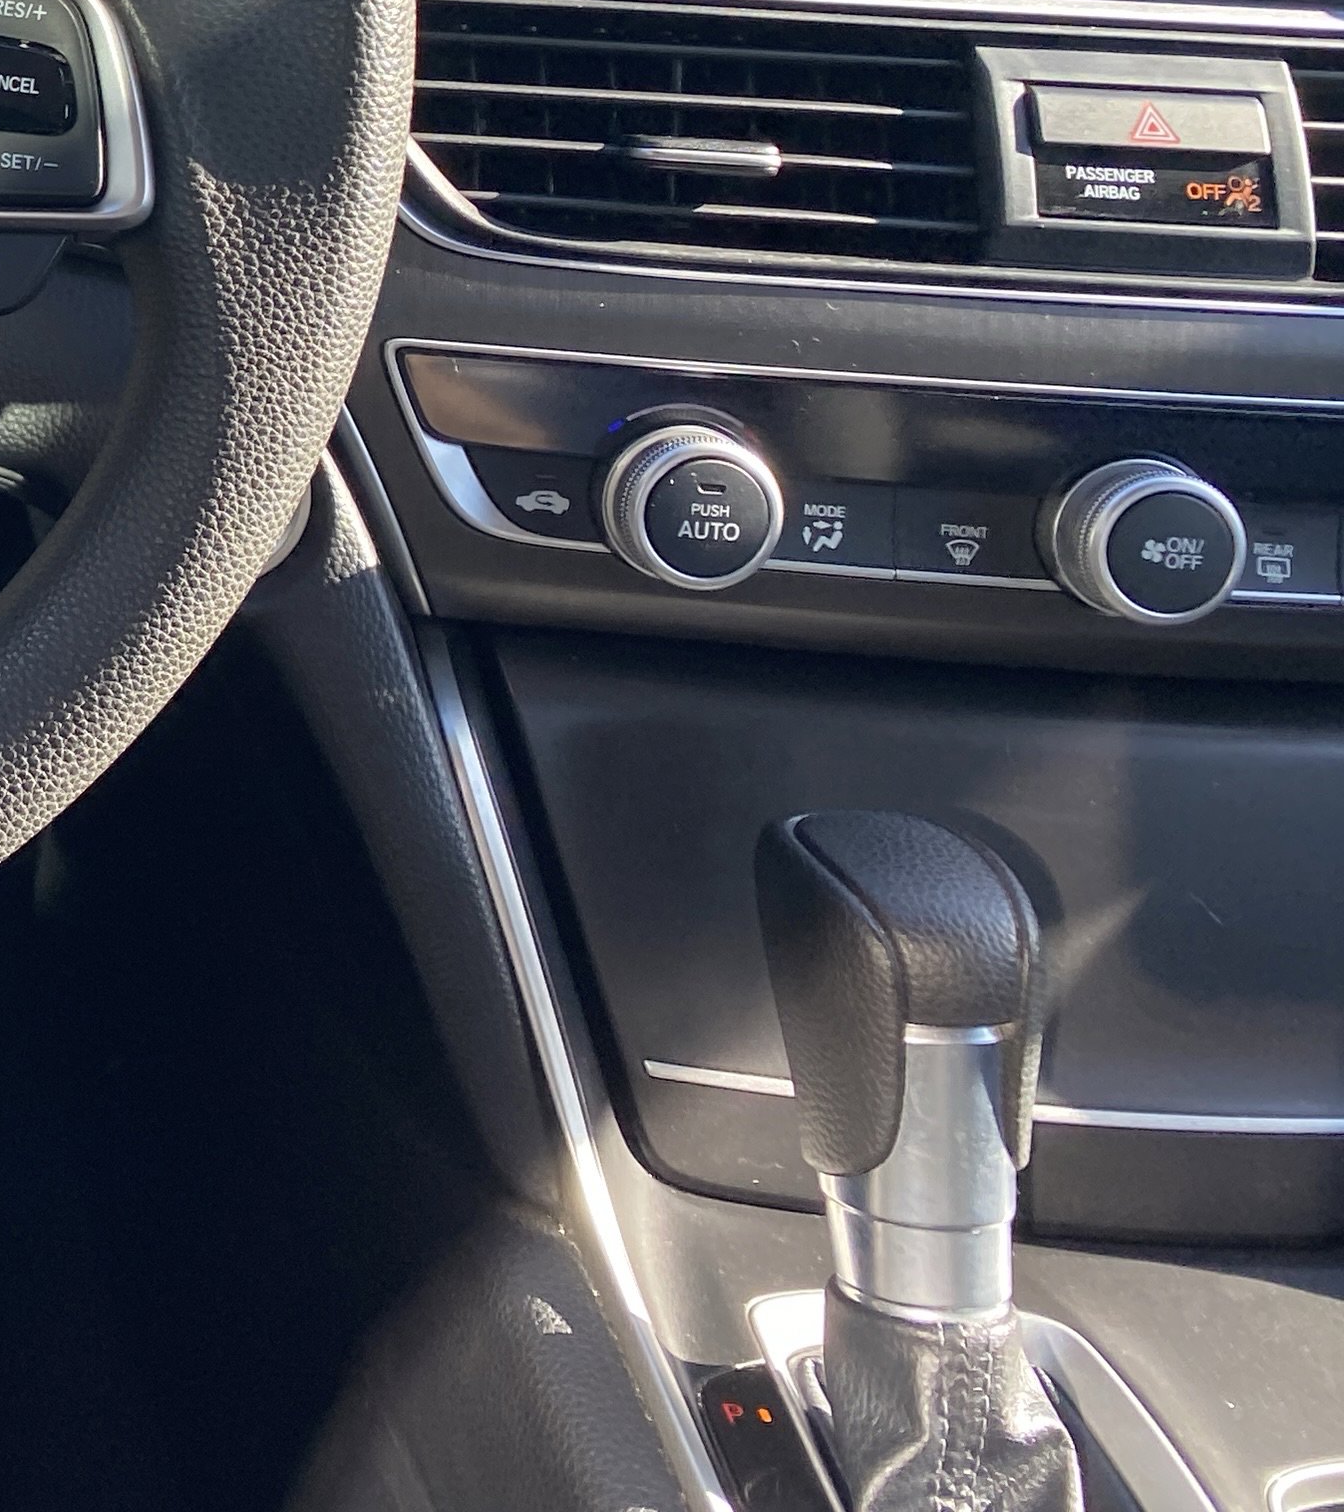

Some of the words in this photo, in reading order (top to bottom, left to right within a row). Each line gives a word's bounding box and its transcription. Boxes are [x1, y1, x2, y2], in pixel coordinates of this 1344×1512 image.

[1065, 165, 1155, 183] PASSENGER
[1083, 184, 1141, 201] AIRBAG
[1185, 182, 1226, 201] OFF
[690, 502, 731, 519] PUSH
[803, 502, 847, 519] MODE
[677, 520, 741, 544] AUTO
[940, 523, 988, 540] FRONT
[1166, 535, 1205, 555] ON/
[1253, 542, 1295, 559] REAR
[1164, 552, 1204, 571] OFF
[721, 1400, 745, 1425] P
